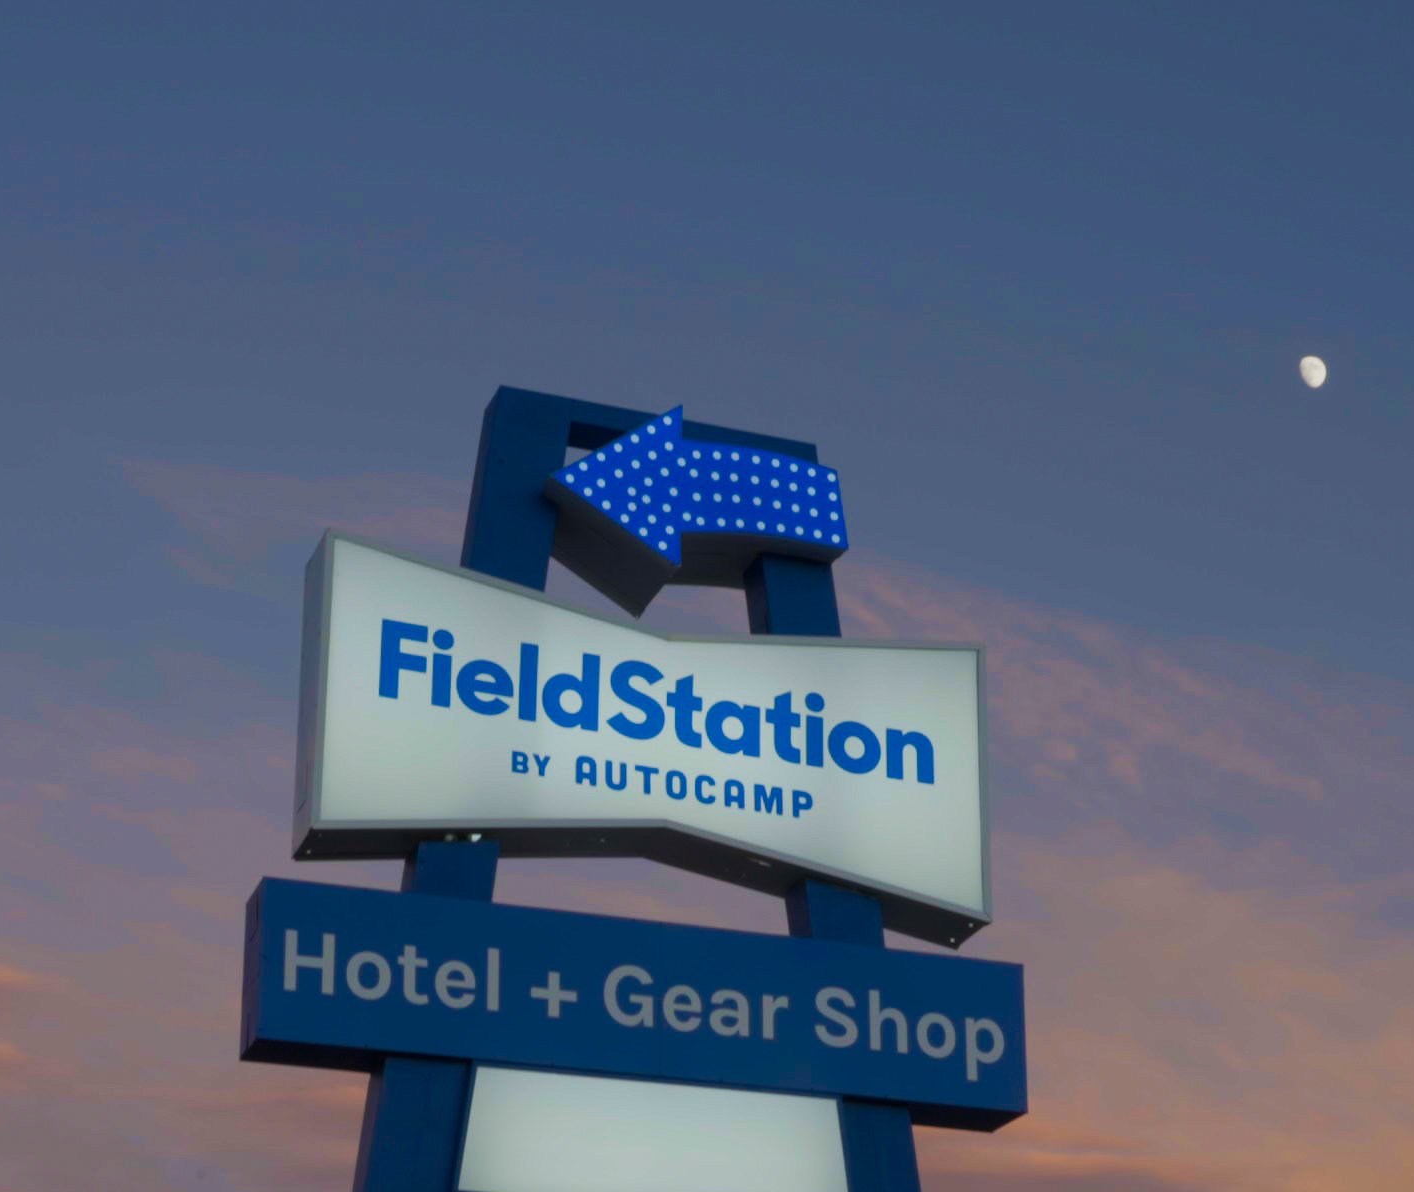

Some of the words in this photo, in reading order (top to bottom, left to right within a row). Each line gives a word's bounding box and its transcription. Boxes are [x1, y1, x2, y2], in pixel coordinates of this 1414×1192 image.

[377, 618, 937, 786] FieldStation
[510, 750, 551, 777] BY
[574, 754, 815, 819] AUTOCAMP
[282, 929, 501, 1012] Hotel
[529, 971, 579, 1019] +
[602, 964, 790, 1040] Gear
[814, 986, 1006, 1082] Shop
